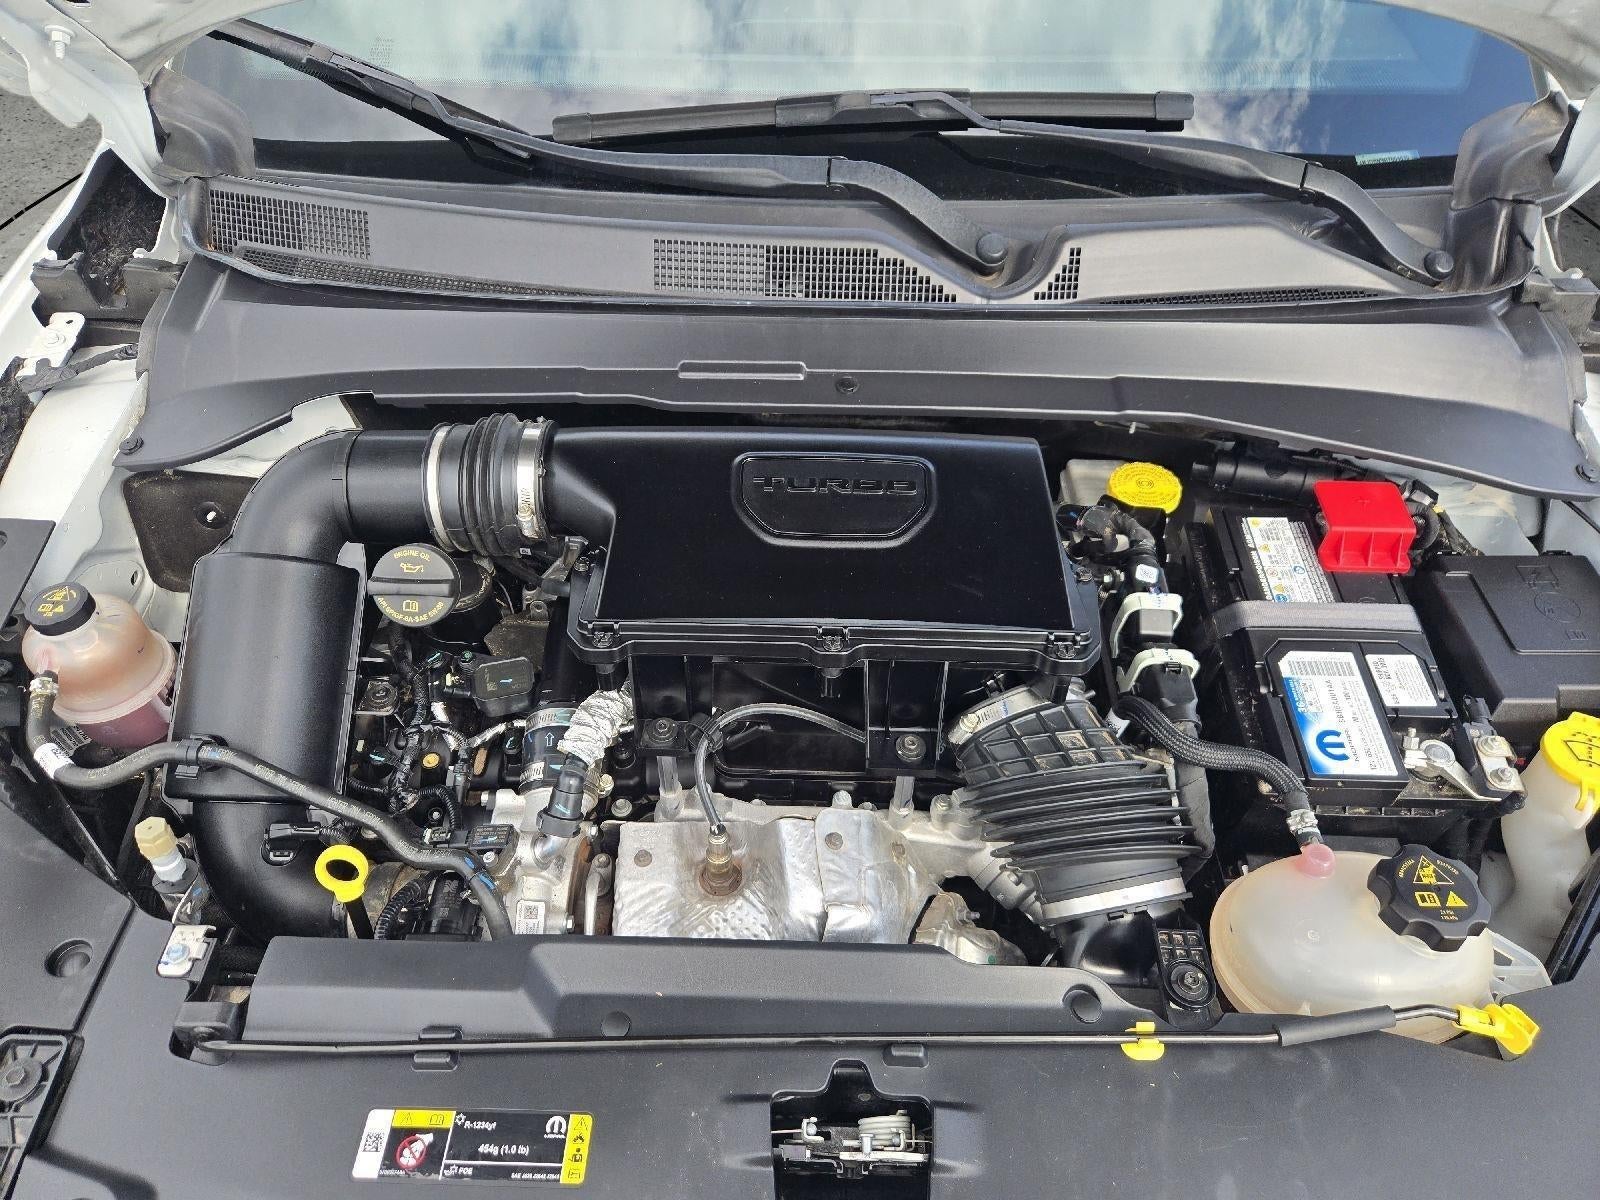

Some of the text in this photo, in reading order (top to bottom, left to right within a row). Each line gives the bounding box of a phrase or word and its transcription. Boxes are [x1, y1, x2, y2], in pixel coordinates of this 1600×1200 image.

[752, 476, 918, 496] TURBO
[393, 550, 431, 562] ENGINE OIL
[464, 1120, 497, 1131] R-1234yf
[478, 1143, 530, 1156] 454g (1.0 lb)
